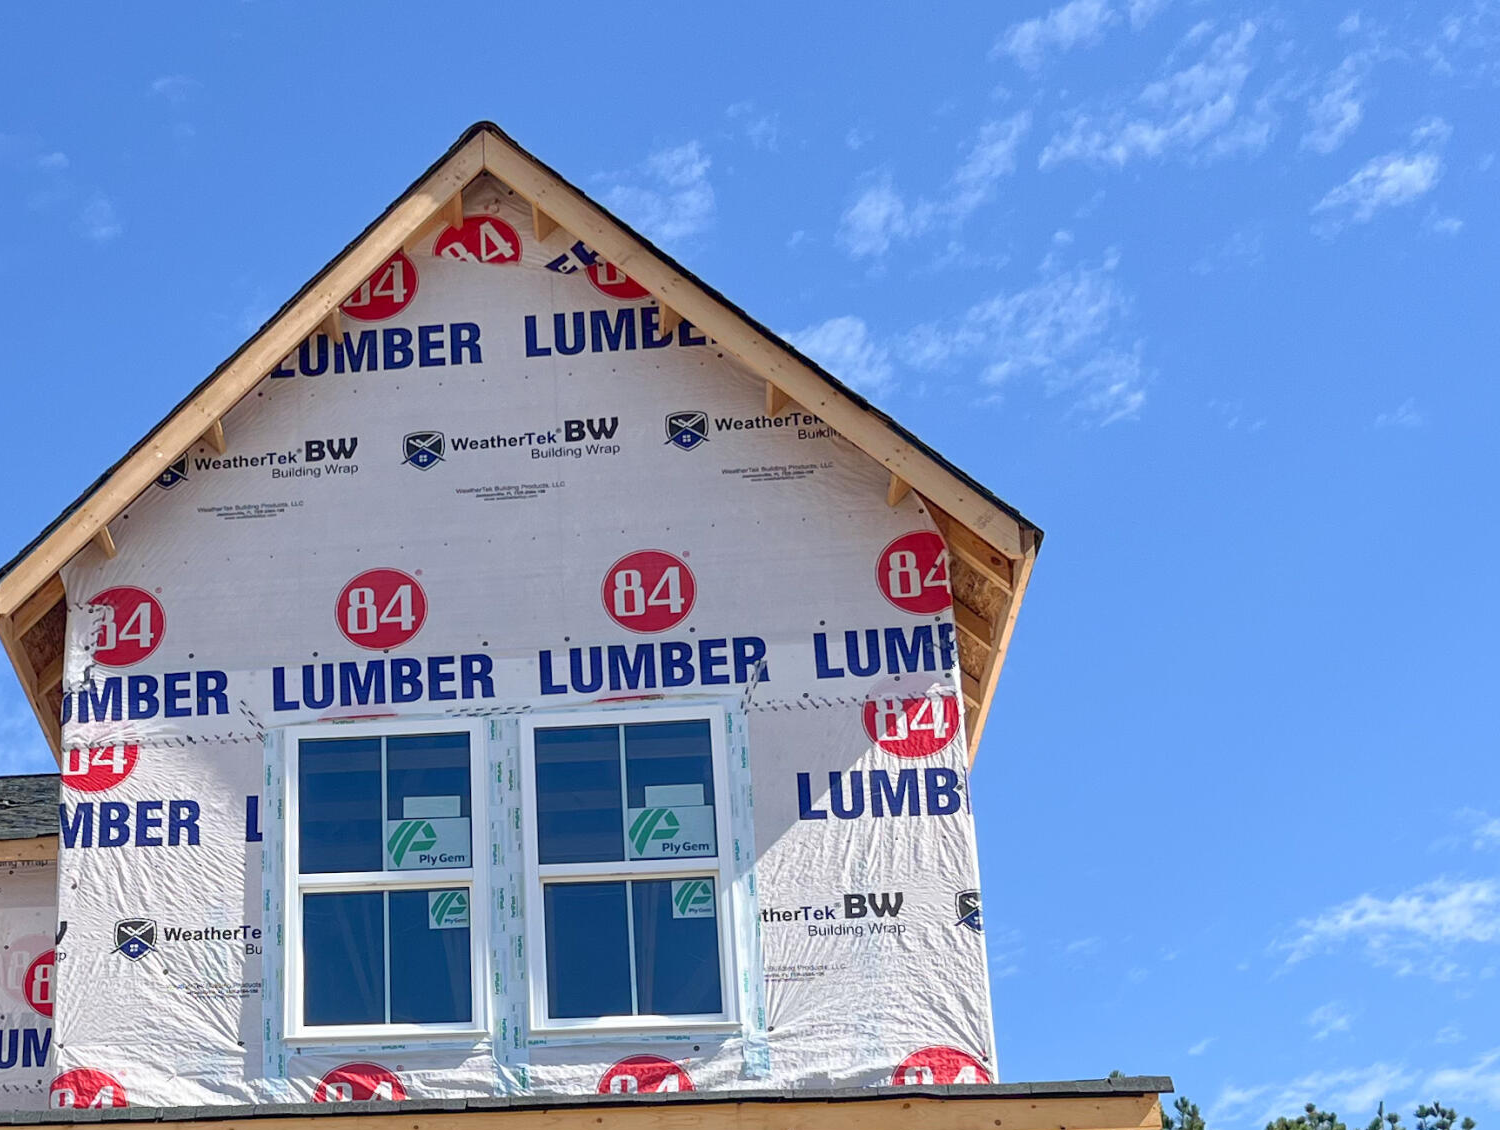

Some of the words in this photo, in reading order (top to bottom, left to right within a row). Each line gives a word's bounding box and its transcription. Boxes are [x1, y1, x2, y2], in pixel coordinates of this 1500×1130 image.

[451, 431, 557, 451] WeatherTek
[564, 416, 619, 442] BW
[195, 452, 297, 471] WeatherTek
[305, 437, 358, 462] BW
[531, 448, 582, 459] Building
[585, 444, 621, 455] Wrap
[272, 466, 321, 479] Building
[324, 464, 358, 476] Wrap
[889, 549, 951, 599] 84
[348, 585, 415, 633] 84
[614, 567, 685, 617] 84
[273, 654, 496, 711] LUMBER
[539, 636, 770, 695] LUMBER
[844, 892, 904, 919] BW
[808, 925, 864, 937] Building
[868, 923, 906, 935] Wrap
